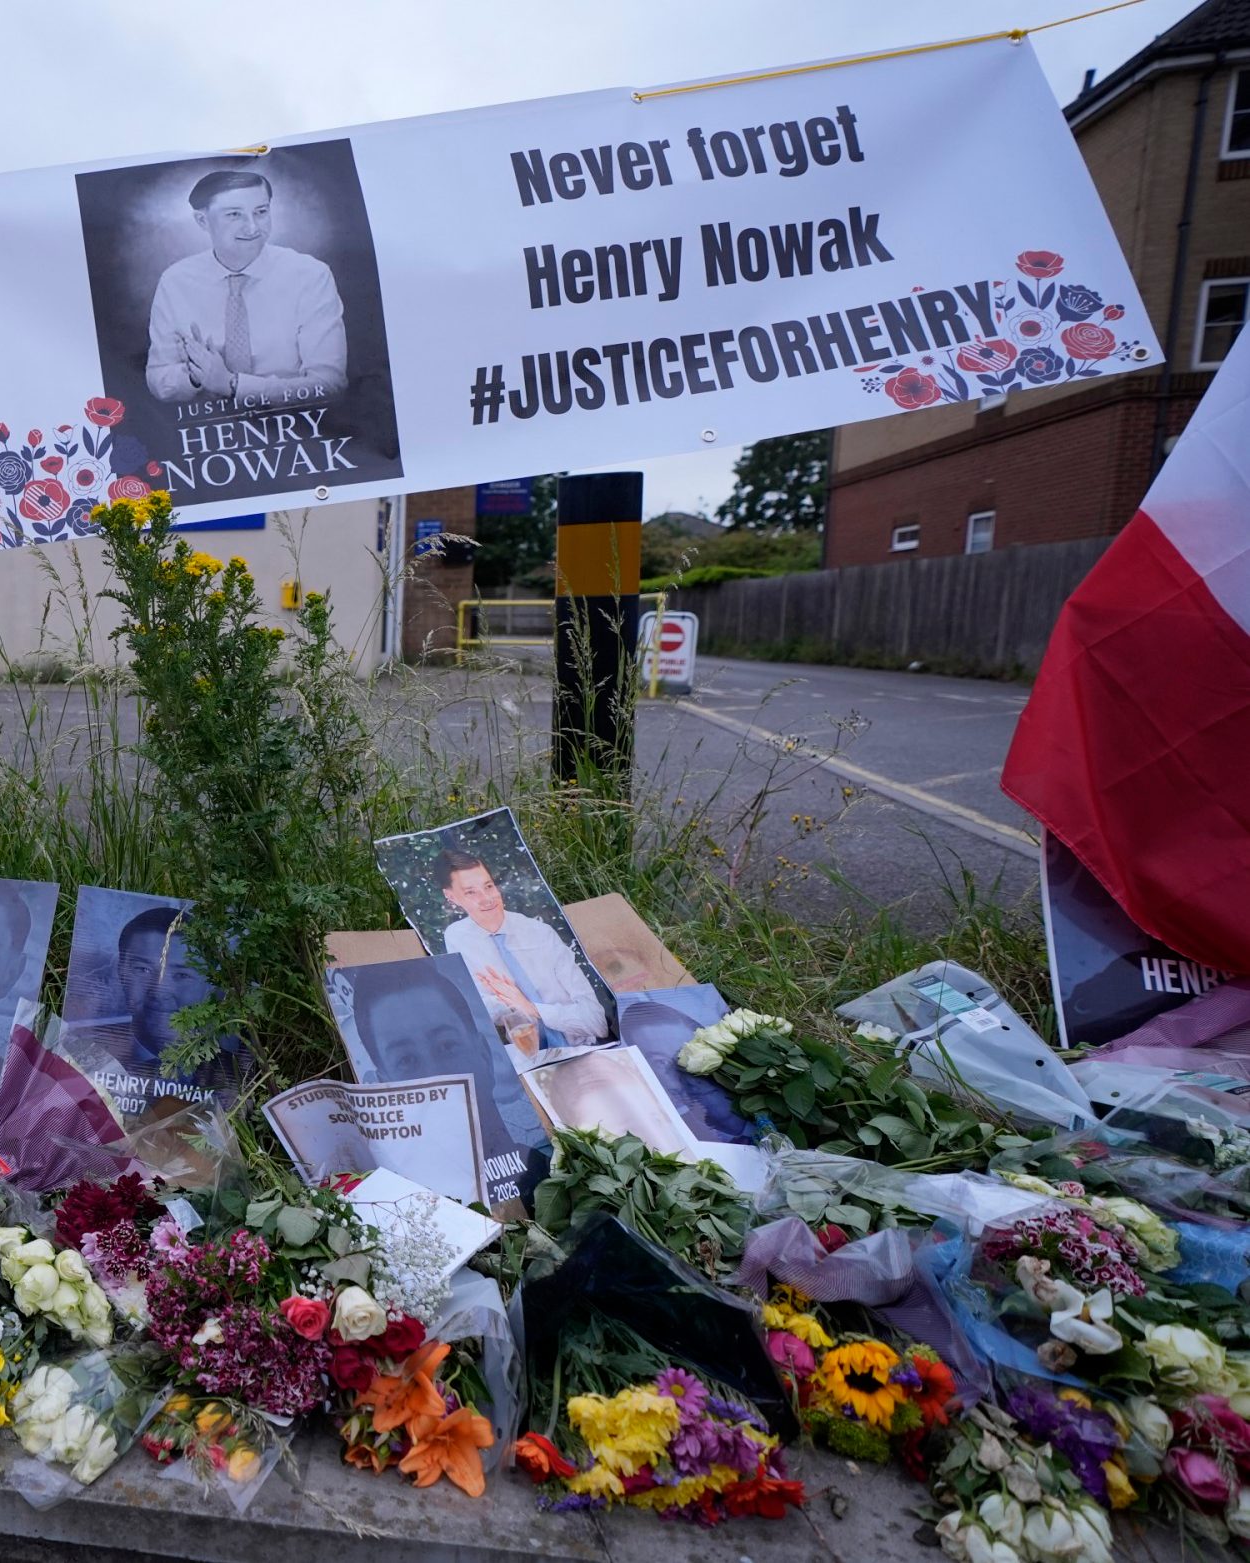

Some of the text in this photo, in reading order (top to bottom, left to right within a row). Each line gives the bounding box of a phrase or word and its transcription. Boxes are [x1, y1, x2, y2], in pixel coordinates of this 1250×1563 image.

[510, 105, 865, 207] Never forget
[522, 206, 895, 310] Henry Nowak
[469, 279, 999, 426] #JUSTICEFORHENRY
[177, 385, 326, 421] JUSTICE FOR
[178, 408, 328, 455] HENRY
[161, 436, 358, 492] NOWAK
[93, 1070, 215, 1104] HENRY NOWAK
[288, 1089, 348, 1111] STUDENT
[429, 1087, 449, 1102] BY
[484, 1150, 528, 1183] NOWAK
[493, 1180, 521, 1202] 2025
